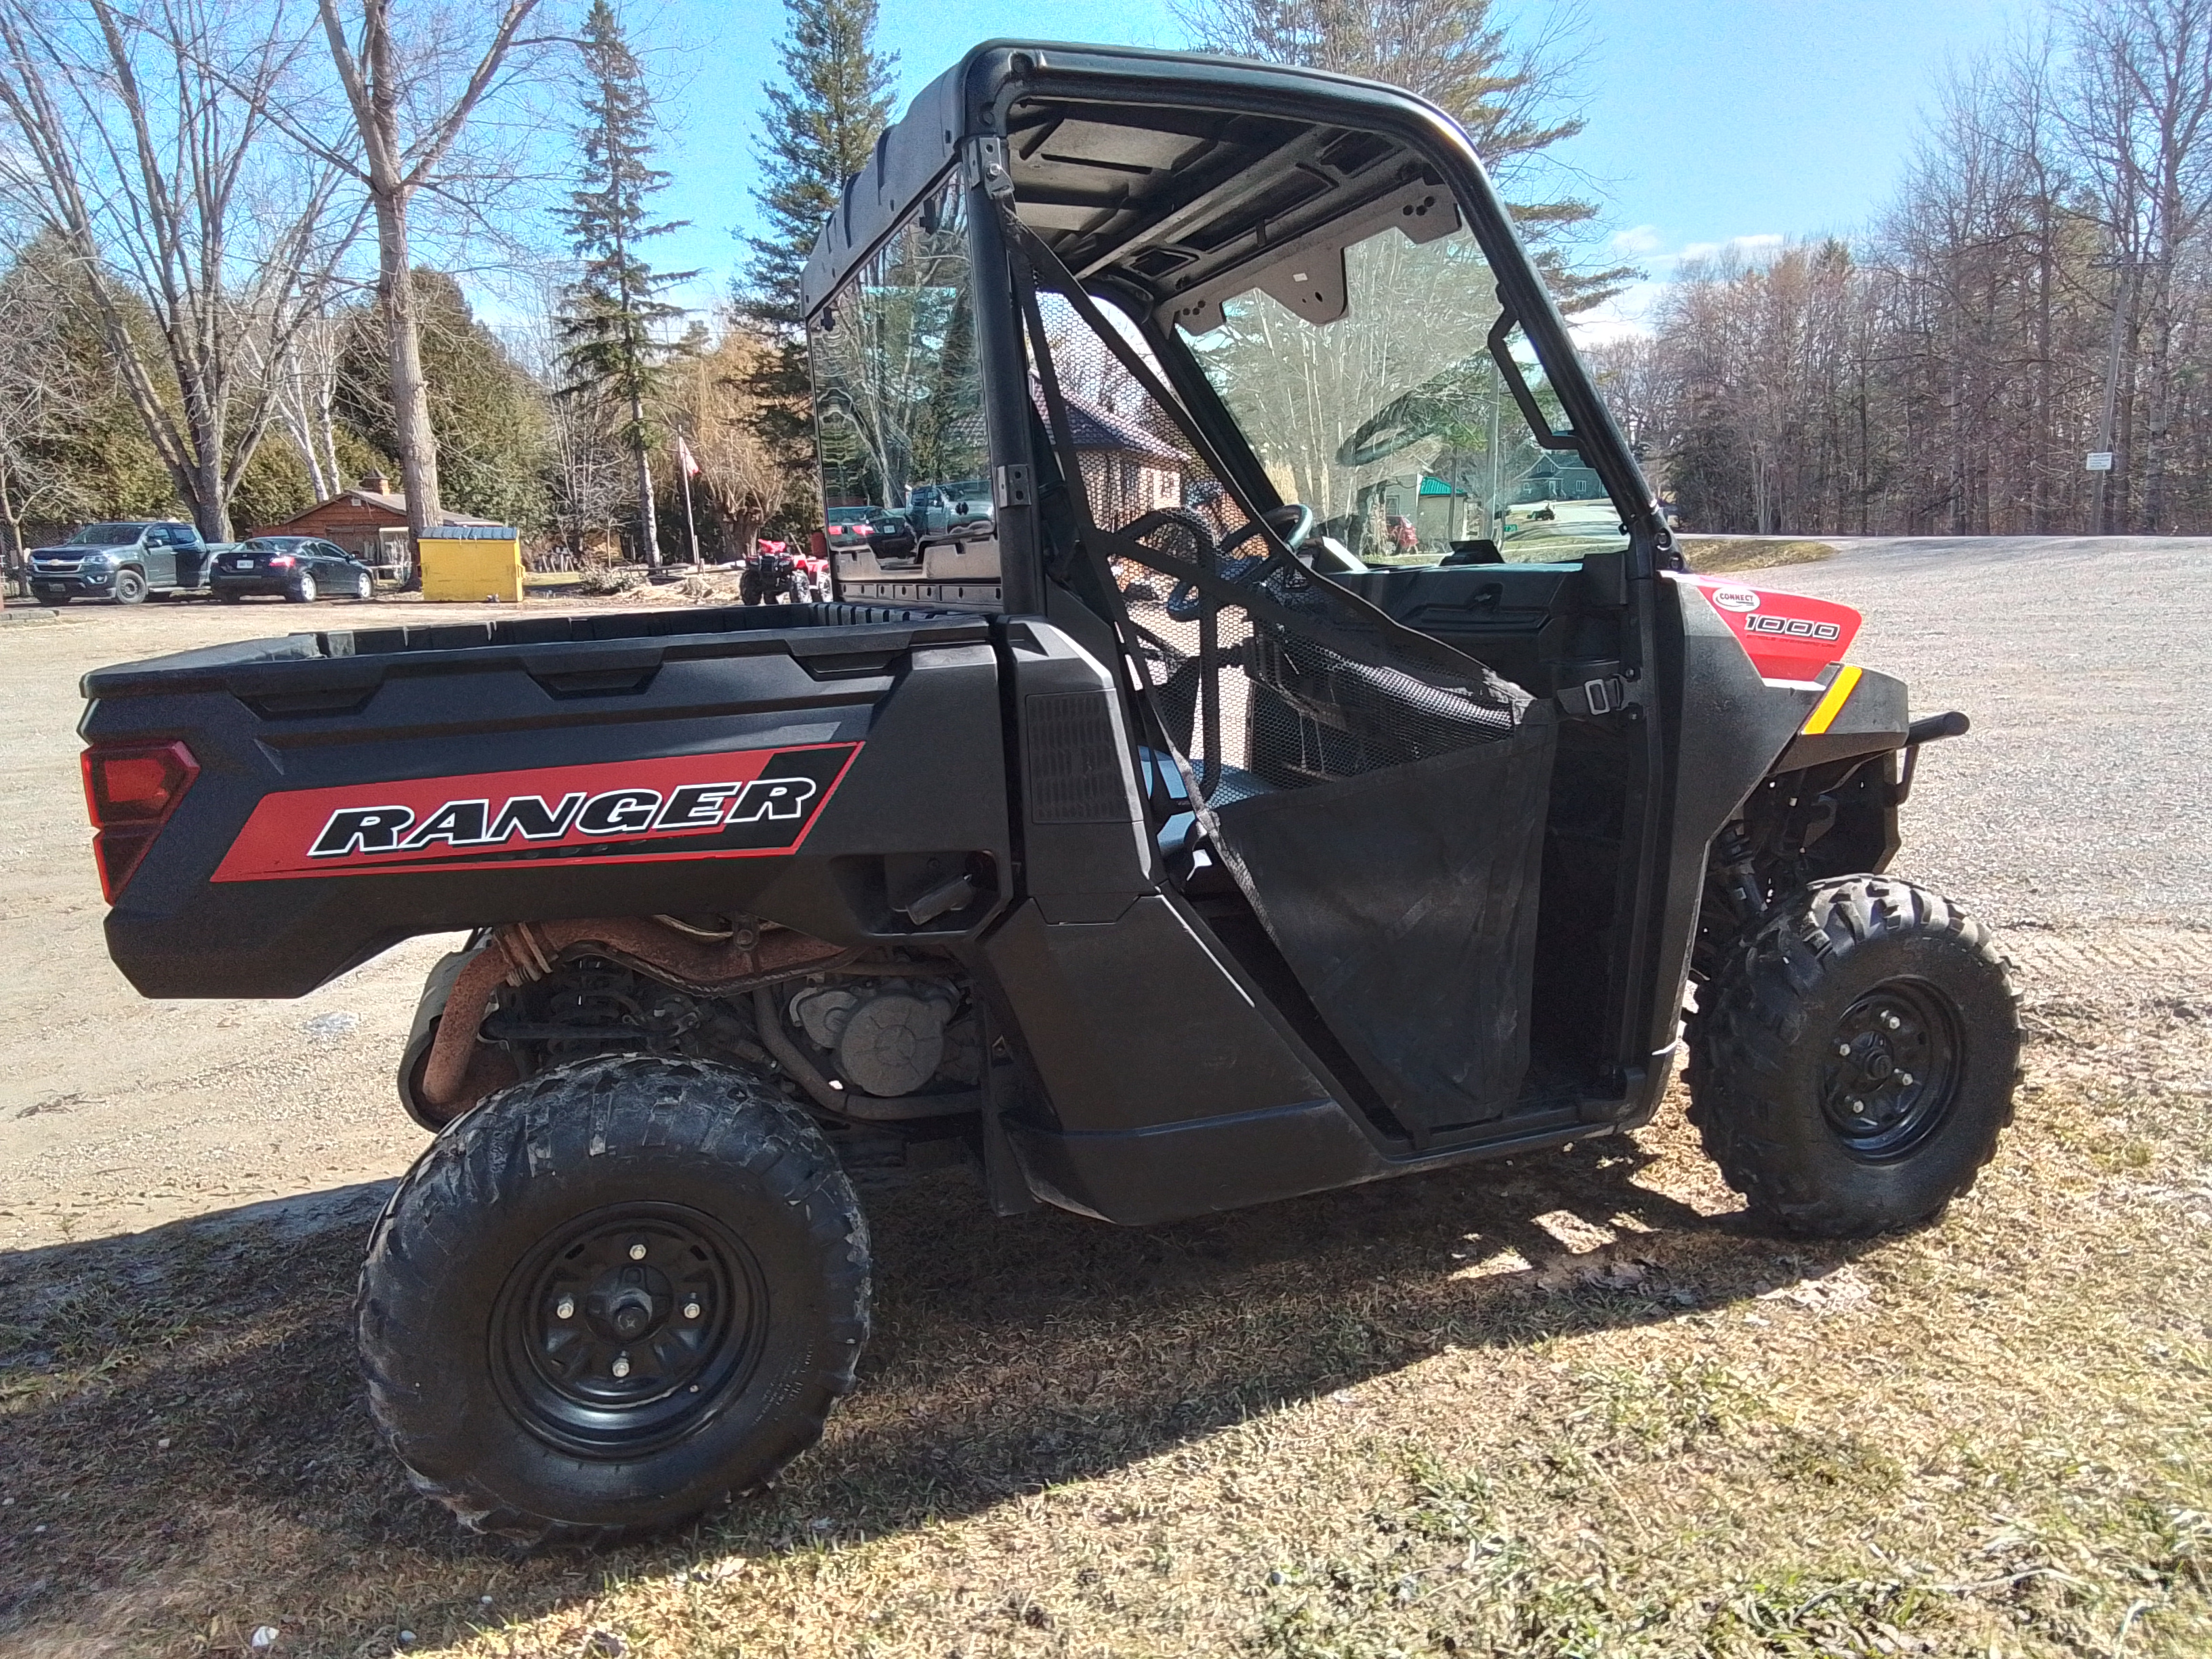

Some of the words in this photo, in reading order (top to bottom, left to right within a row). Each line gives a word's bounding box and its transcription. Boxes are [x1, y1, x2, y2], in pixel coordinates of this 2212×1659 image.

[1719, 592, 1754, 602] CONNECT
[1744, 613, 1841, 640] 1000
[307, 777, 817, 857] RANGER
